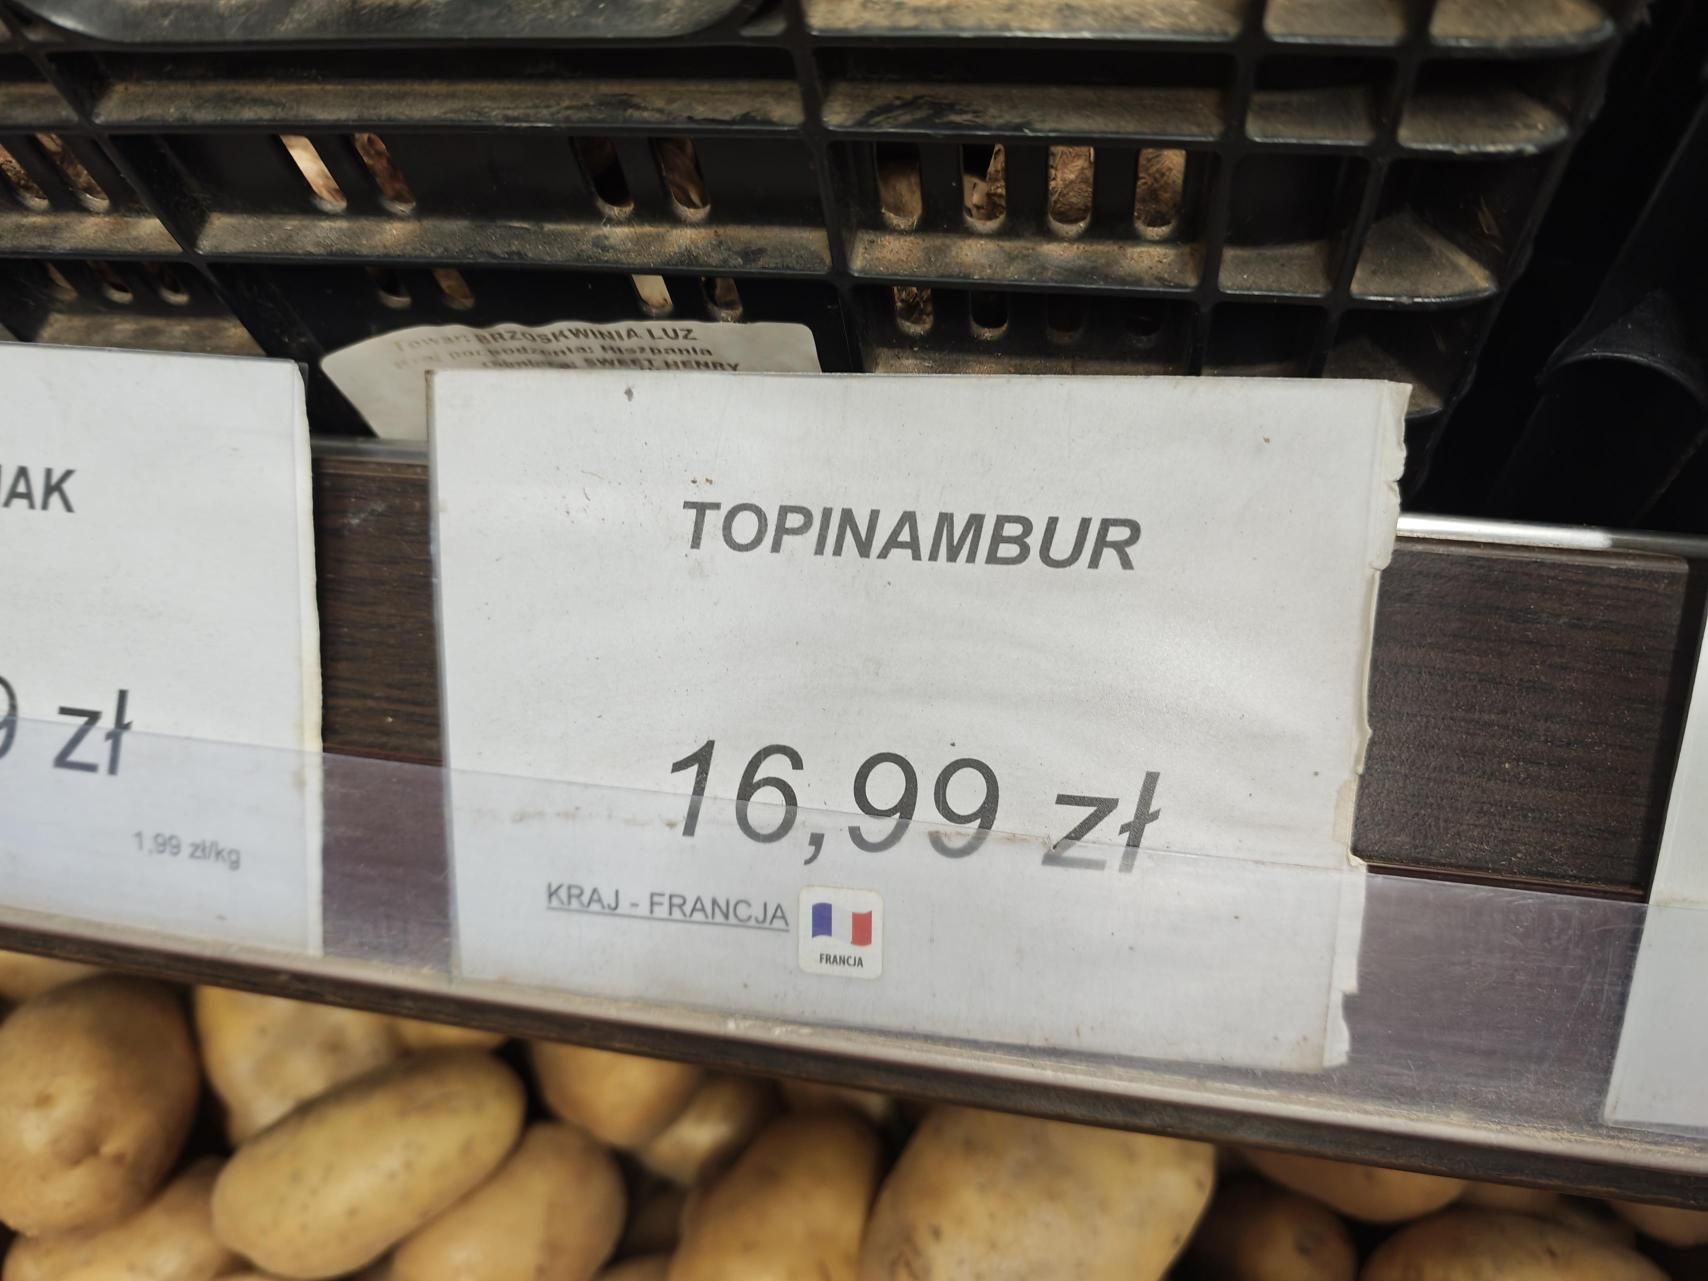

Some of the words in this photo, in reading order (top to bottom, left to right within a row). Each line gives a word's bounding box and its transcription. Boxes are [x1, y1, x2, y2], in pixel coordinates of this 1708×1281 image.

[475, 327, 639, 345] BRZOSKWINIA
[647, 327, 698, 341] LUZ
[663, 359, 740, 372] HENRY
[0, 463, 76, 514] AK
[682, 500, 1142, 571] TOPINAMBUR
[53, 689, 133, 776] zł
[670, 739, 1000, 866] 16,99
[1041, 770, 1161, 873] zł
[188, 839, 241, 871] zł/kg
[547, 882, 620, 912] KRAJ
[649, 892, 789, 928] FRANCJA
[819, 952, 864, 968] FRANCJA
